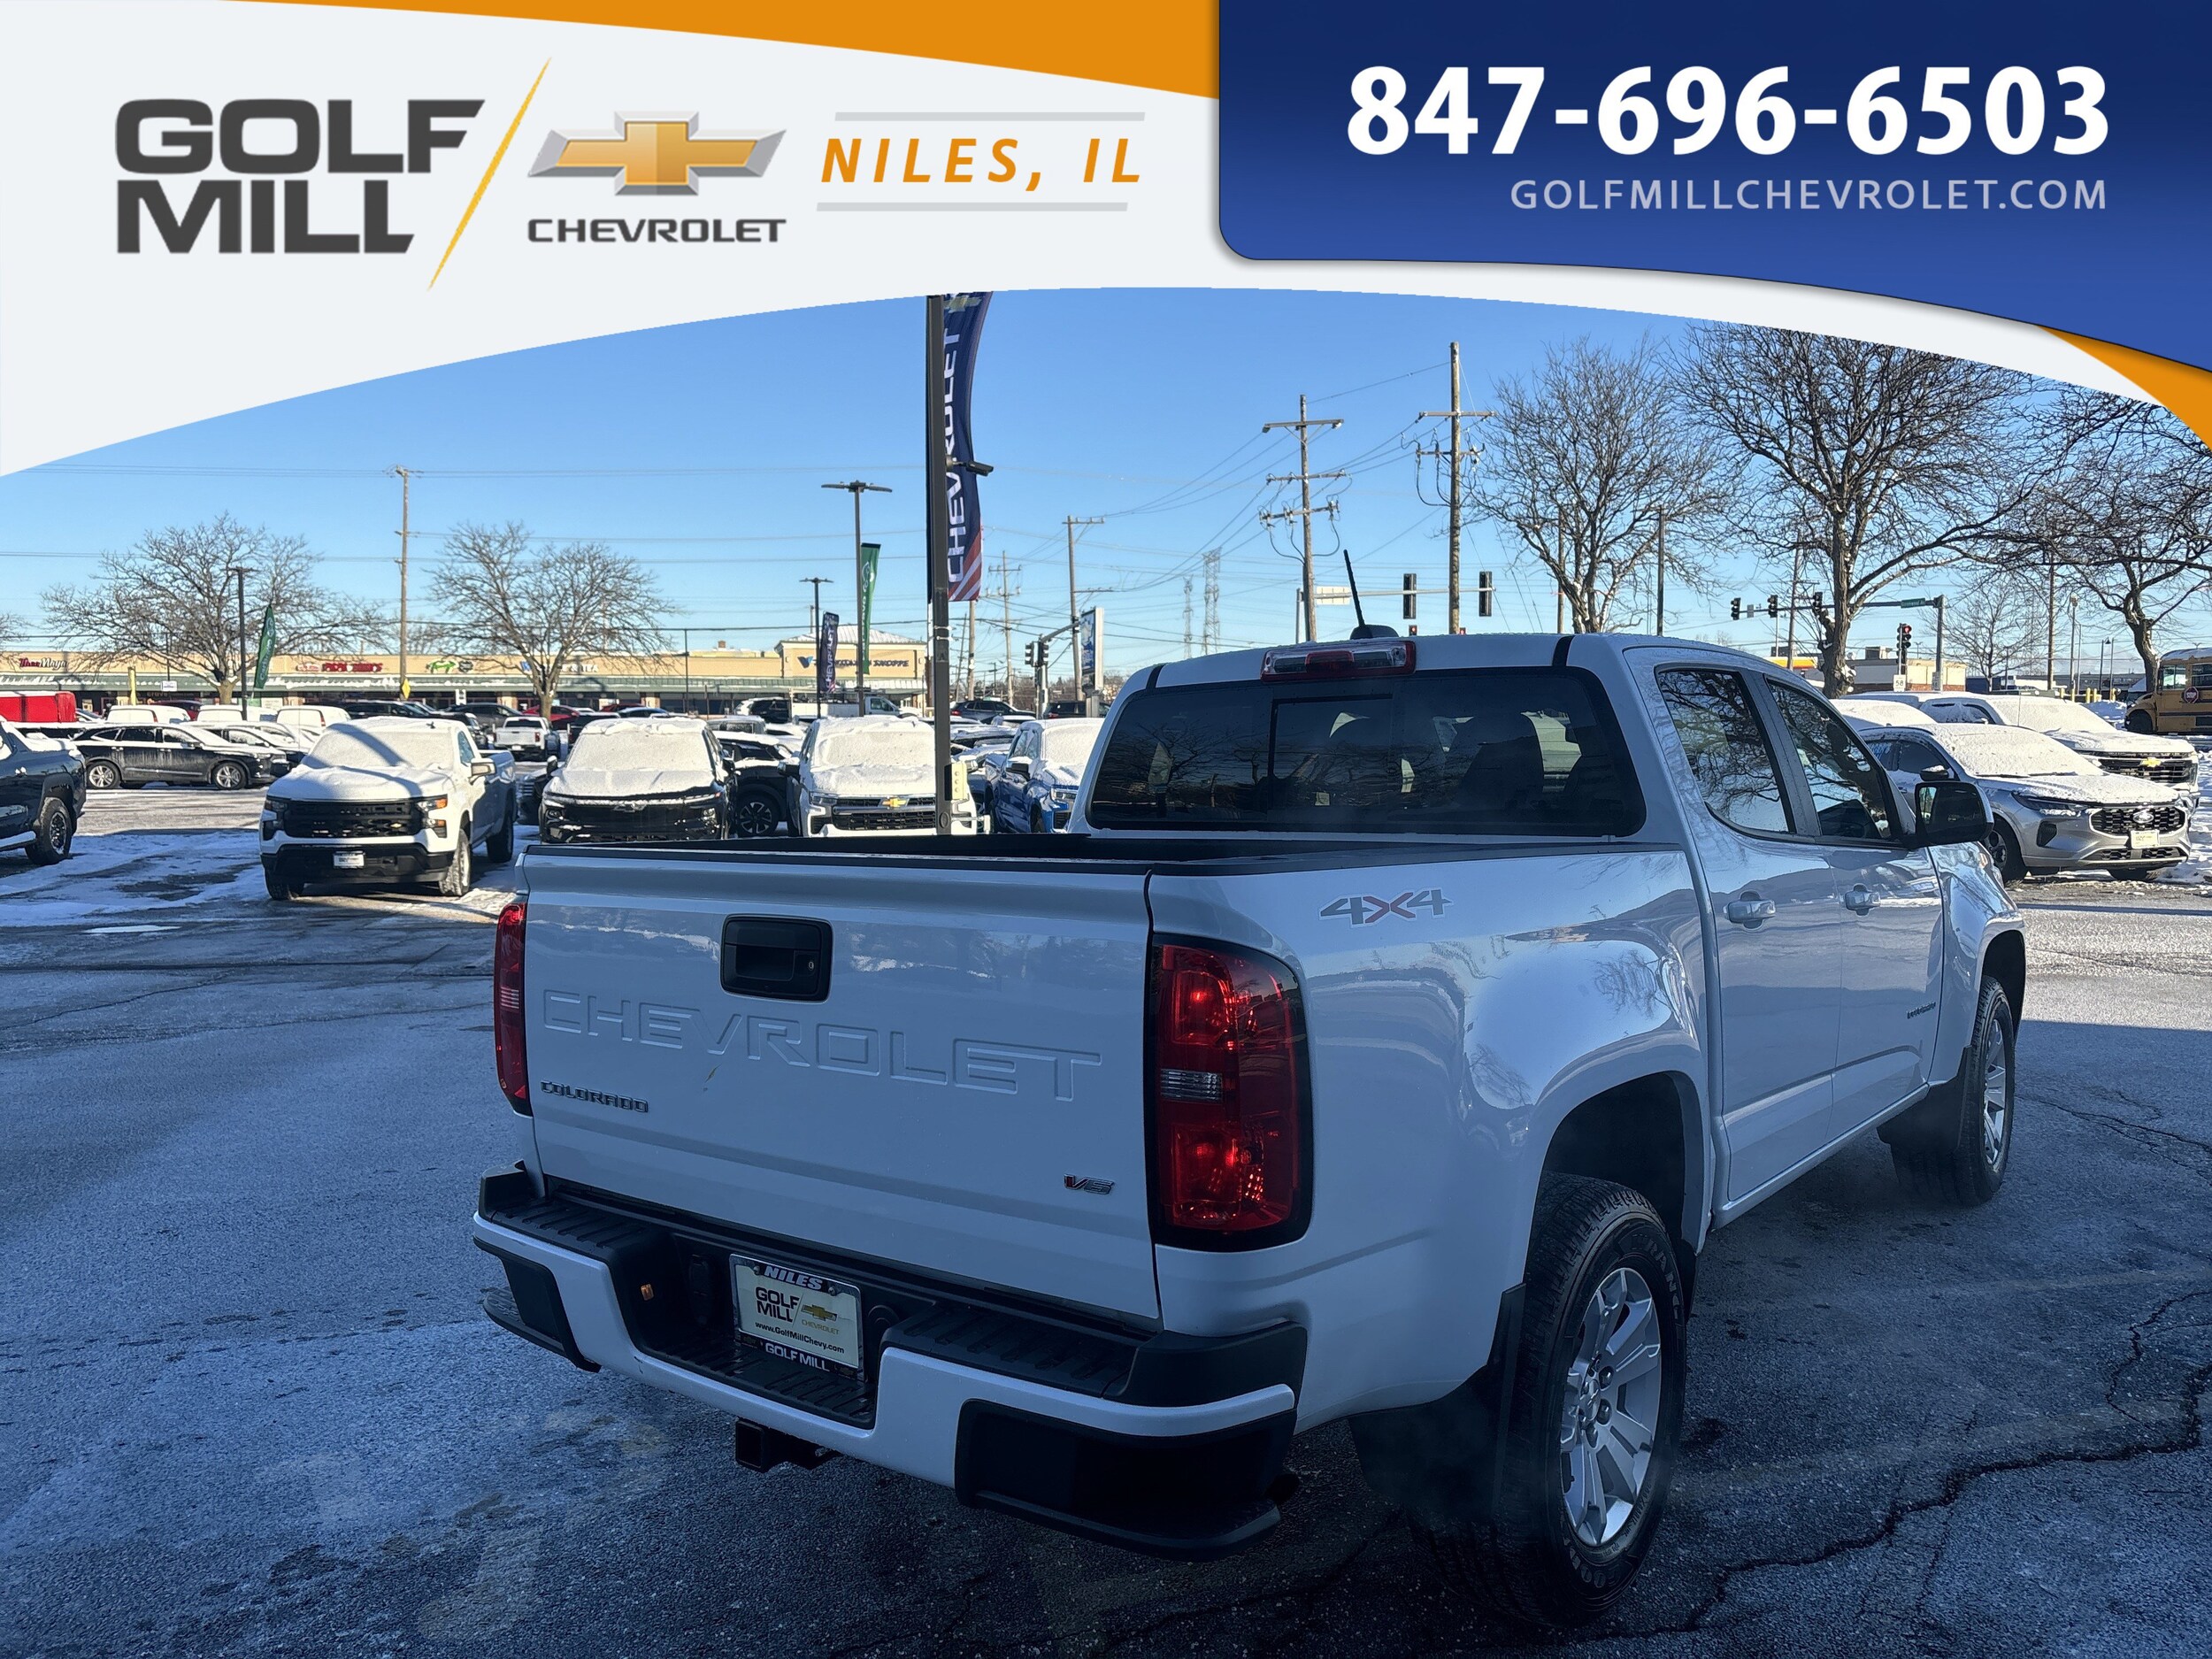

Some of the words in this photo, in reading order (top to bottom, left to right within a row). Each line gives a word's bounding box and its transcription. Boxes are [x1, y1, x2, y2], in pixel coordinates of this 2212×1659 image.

[542, 988, 1102, 1102] CHEVROLET
[540, 1079, 650, 1114] COLORADO
[1064, 1173, 1116, 1195] V6
[764, 1265, 823, 1291] NILES
[755, 1286, 800, 1309] GOLF
[757, 1302, 794, 1323] MILL
[755, 1321, 845, 1354] www.GolfMillChevy.com
[802, 1318, 840, 1335] CHEVROLET
[765, 1342, 797, 1362] GOLF
[799, 1352, 830, 1372] MILL
